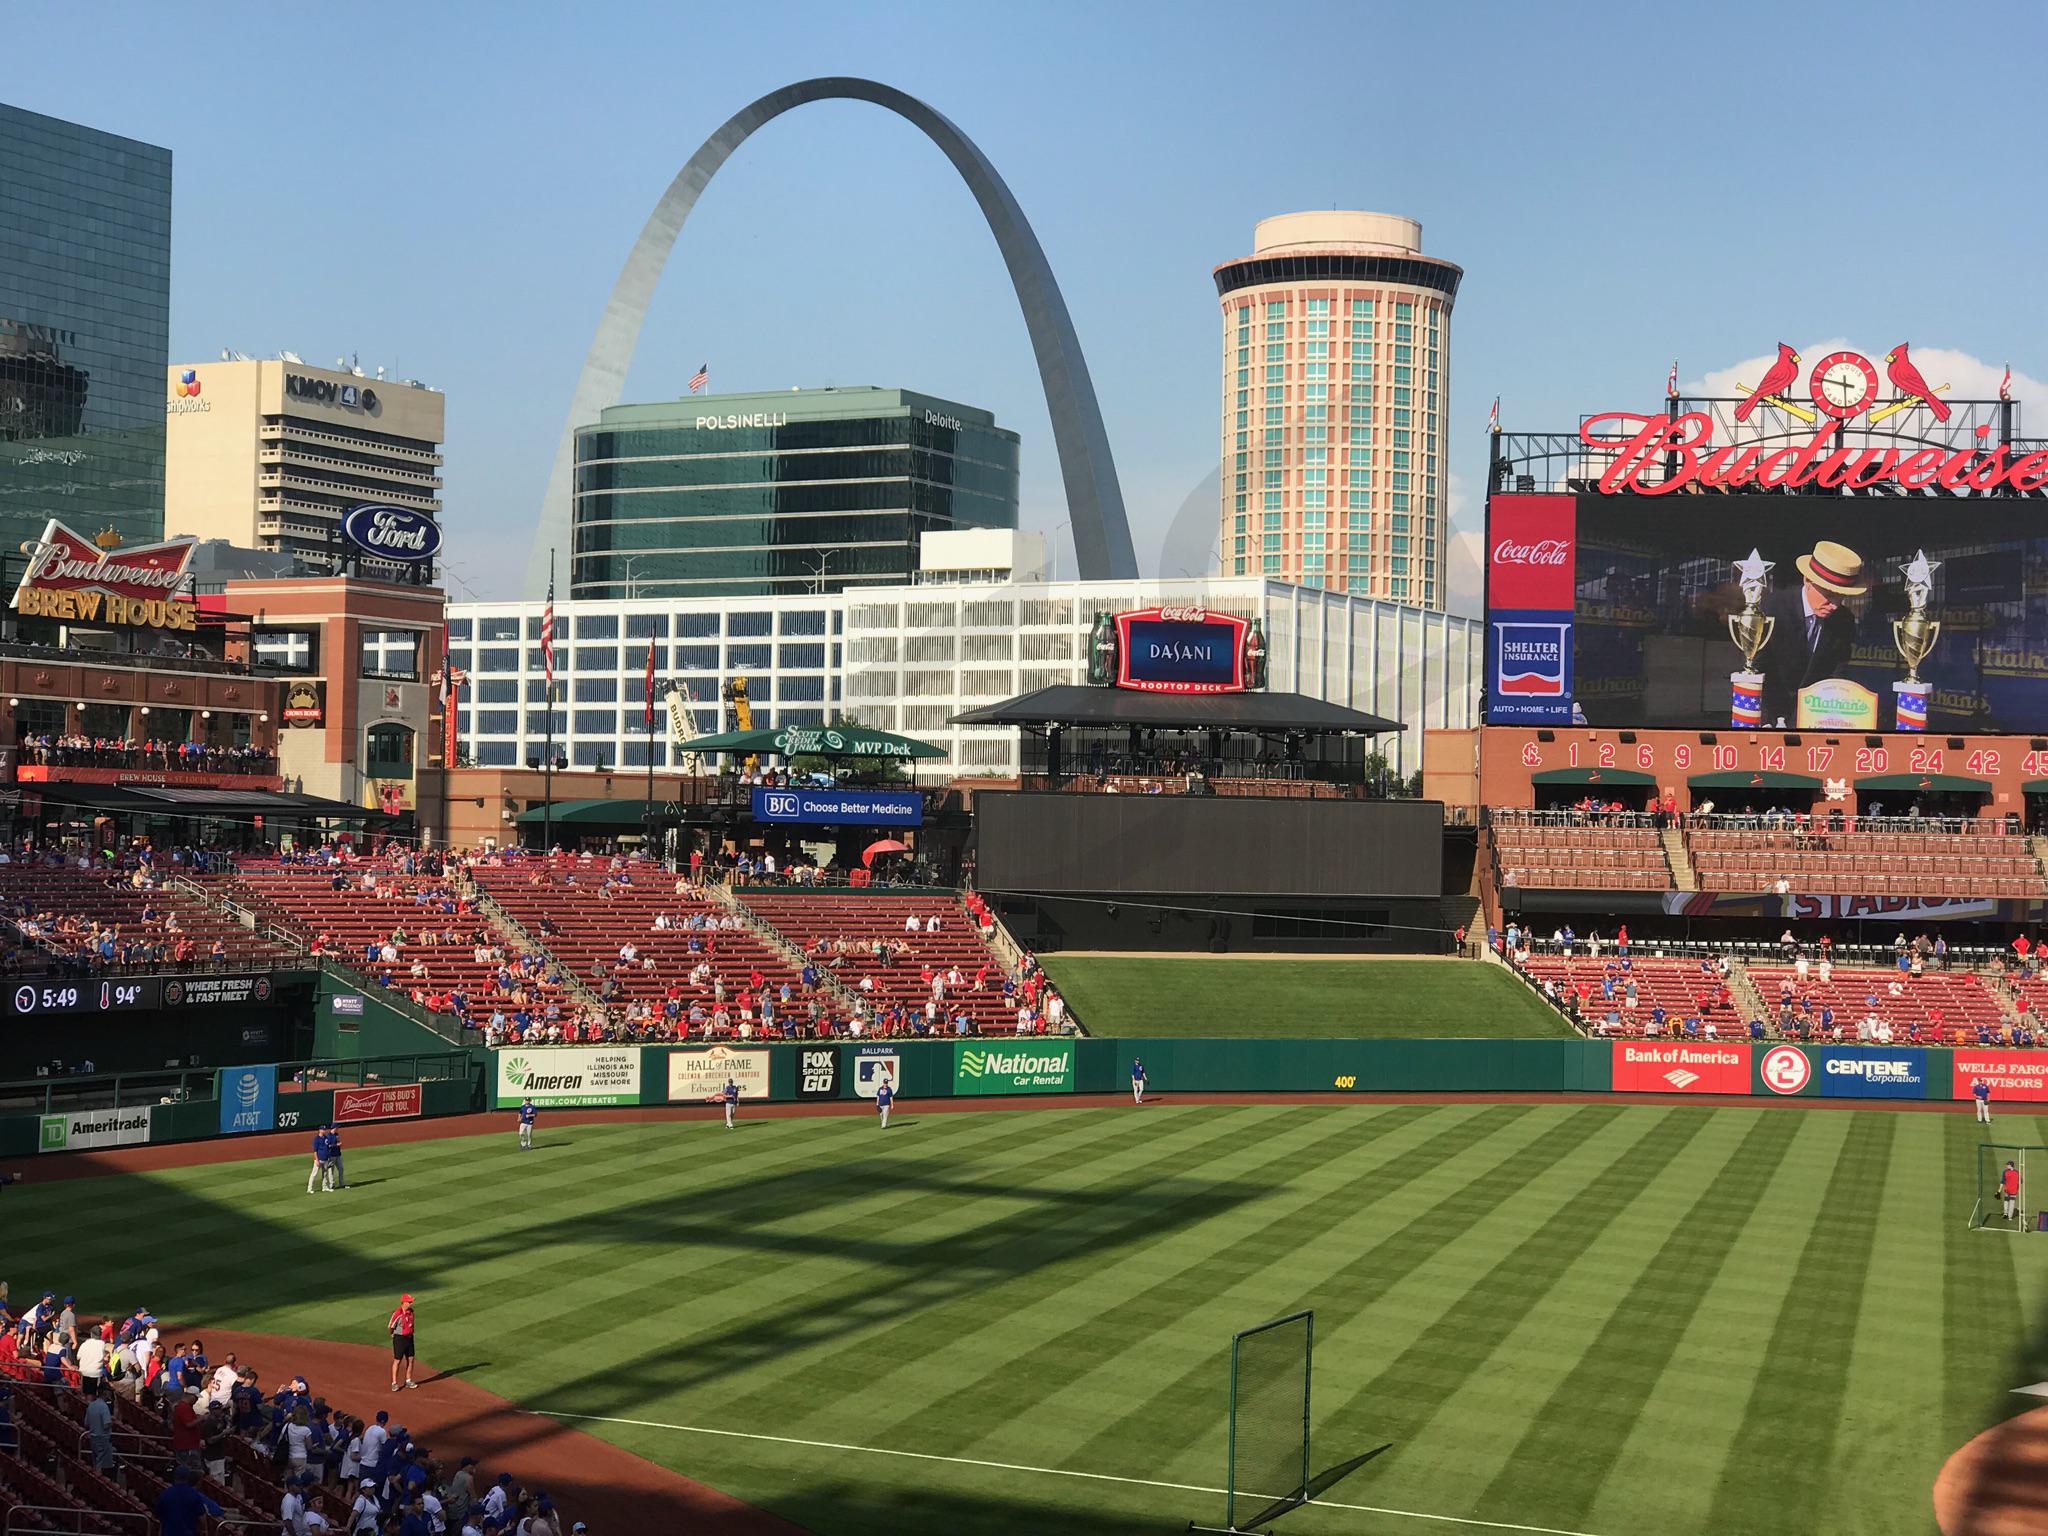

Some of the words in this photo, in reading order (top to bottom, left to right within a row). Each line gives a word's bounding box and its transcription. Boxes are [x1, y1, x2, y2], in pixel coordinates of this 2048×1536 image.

[285, 373, 338, 402] KMOV
[1824, 387, 1865, 405] CARDNALS
[696, 412, 787, 430] POLSINELLI
[367, 511, 427, 550] Ford
[1493, 539, 1571, 565] Coca-Cola
[20, 540, 195, 590] Budweiser
[18, 586, 101, 621] BREW
[105, 594, 196, 631] HOUSE
[1150, 641, 1211, 663] DASANI
[1503, 642, 1559, 654] SHELTER
[1504, 653, 1559, 662] INSURANCE
[1140, 682, 1190, 691] ROOFTOP
[1195, 684, 1222, 692] DECK
[1493, 705, 1515, 713] AUTO
[786, 725, 823, 739] SCOTT
[775, 734, 817, 748] CREDIT
[785, 743, 823, 755] UNION
[854, 742, 882, 755] MVP
[882, 742, 911, 756] Deck
[1569, 742, 1578, 767] 1
[1599, 743, 1615, 768] 2
[1637, 743, 1653, 769] 6
[1675, 744, 1691, 769] 9
[1713, 745, 1738, 770] 10
[1760, 746, 1785, 771] 14
[1807, 747, 1834, 772] 17
[1856, 748, 1888, 773] 20
[1910, 749, 1944, 774] 24
[1966, 750, 2000, 775] 42
[120, 773, 140, 781] BREW
[142, 774, 166, 783] HOUSE
[769, 797, 796, 813] BJC
[803, 802, 839, 813] Choose
[841, 803, 870, 814] Better
[872, 804, 912, 815] Medicine
[185, 981, 220, 992] WHERE
[221, 979, 253, 990] FRESH
[42, 988, 77, 1008] 5:49
[186, 993, 194, 1003] &
[195, 992, 222, 1003] FAST
[221, 991, 250, 1001] MEET
[802, 1051, 833, 1068] FOX
[1625, 1048, 1661, 1062] Bank
[1663, 1049, 1678, 1062] of
[1680, 1050, 1739, 1064] America
[687, 1060, 714, 1071] HALL
[724, 1059, 752, 1070] FAME
[802, 1067, 834, 1076] SPORTS
[1777, 1056, 1794, 1083] 2
[1826, 1059, 1909, 1076] CENTENE
[1957, 1063, 2006, 1074] WELLS
[2009, 1064, 2048, 1075] FARG
[524, 1072, 582, 1090] Ameren
[803, 1075, 832, 1092] GO
[1013, 1076, 1030, 1086] Car
[1033, 1075, 1063, 1085] Rental
[1866, 1074, 1920, 1084] Corporation
[1970, 1077, 2042, 1088] ADVISORS
[691, 1082, 721, 1093] Edward
[722, 1083, 747, 1093] Jes
[344, 1099, 376, 1110] Budweiser
[382, 1092, 396, 1101] THIS
[397, 1090, 416, 1100] BUD'S
[382, 1103, 394, 1112] FOR
[233, 1112, 261, 1127] AT&T
[44, 1124, 63, 1143] TD
[71, 1116, 148, 1136] Ameritrade
